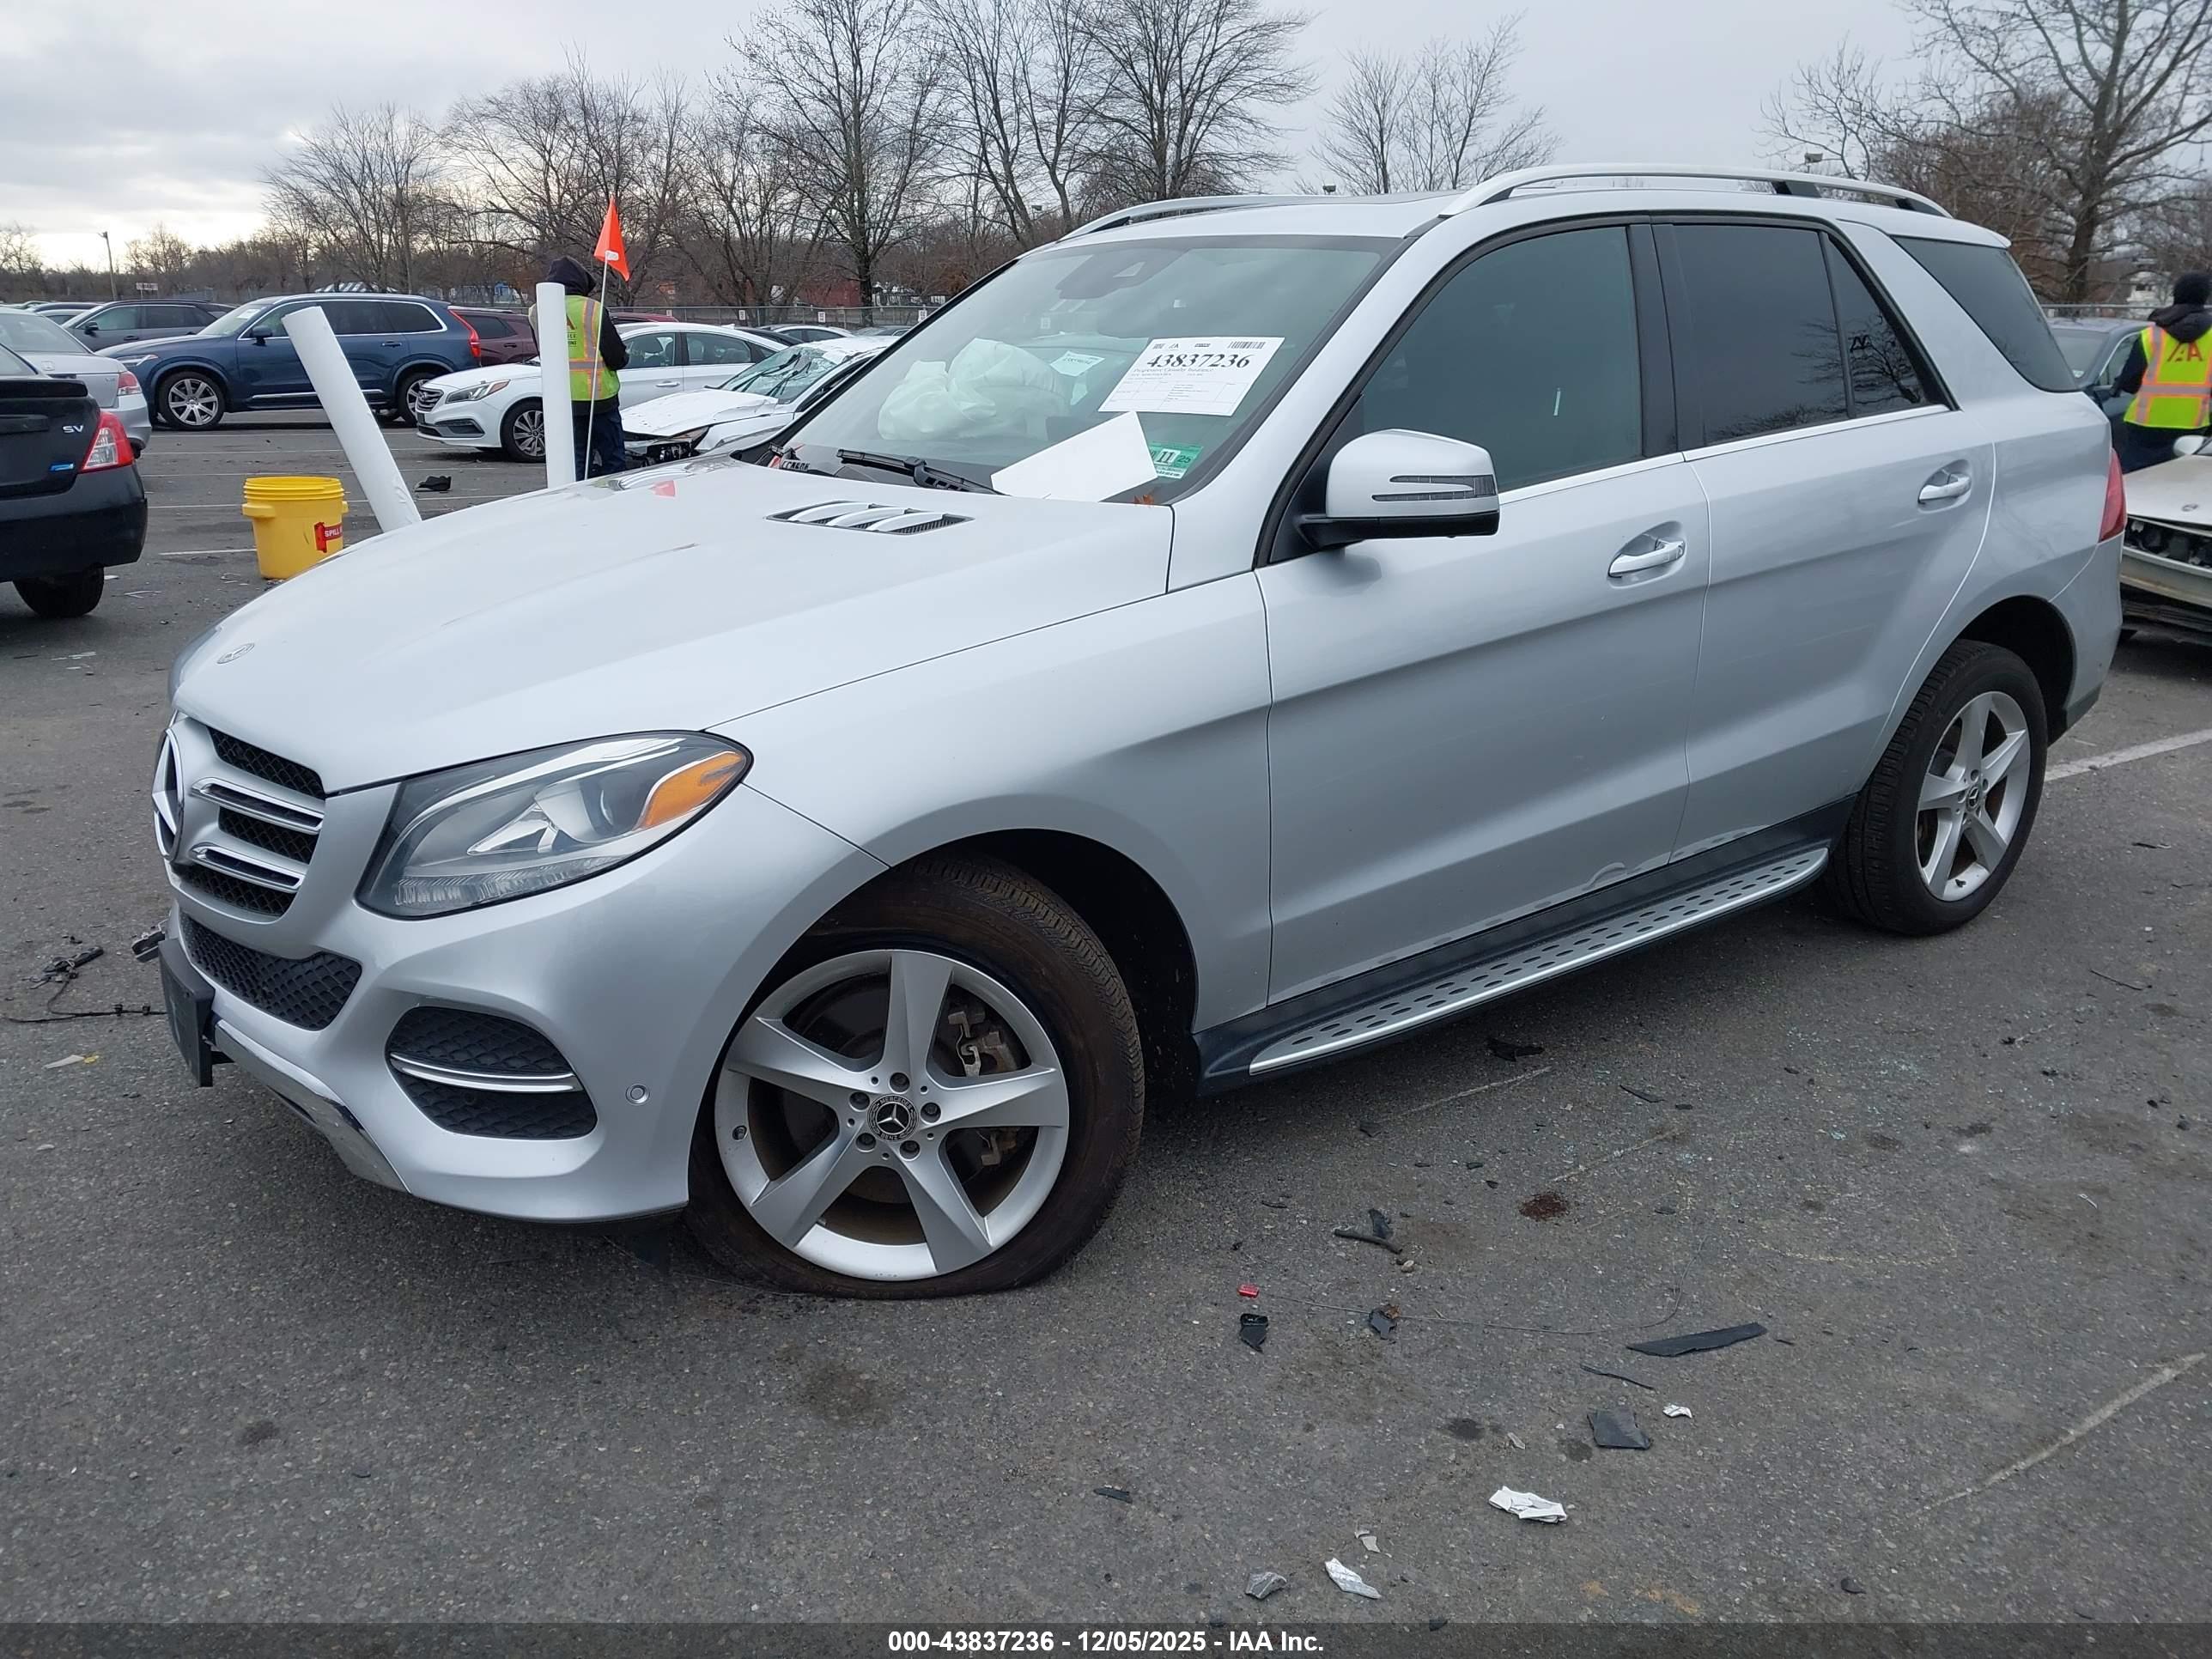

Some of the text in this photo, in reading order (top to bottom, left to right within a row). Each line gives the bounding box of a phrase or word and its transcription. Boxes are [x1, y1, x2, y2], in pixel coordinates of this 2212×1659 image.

[1147, 354, 1255, 368] 43837236
[63, 425, 84, 434] SV
[1177, 455, 1191, 464] 25
[879, 1096, 913, 1109] MERCEDES
